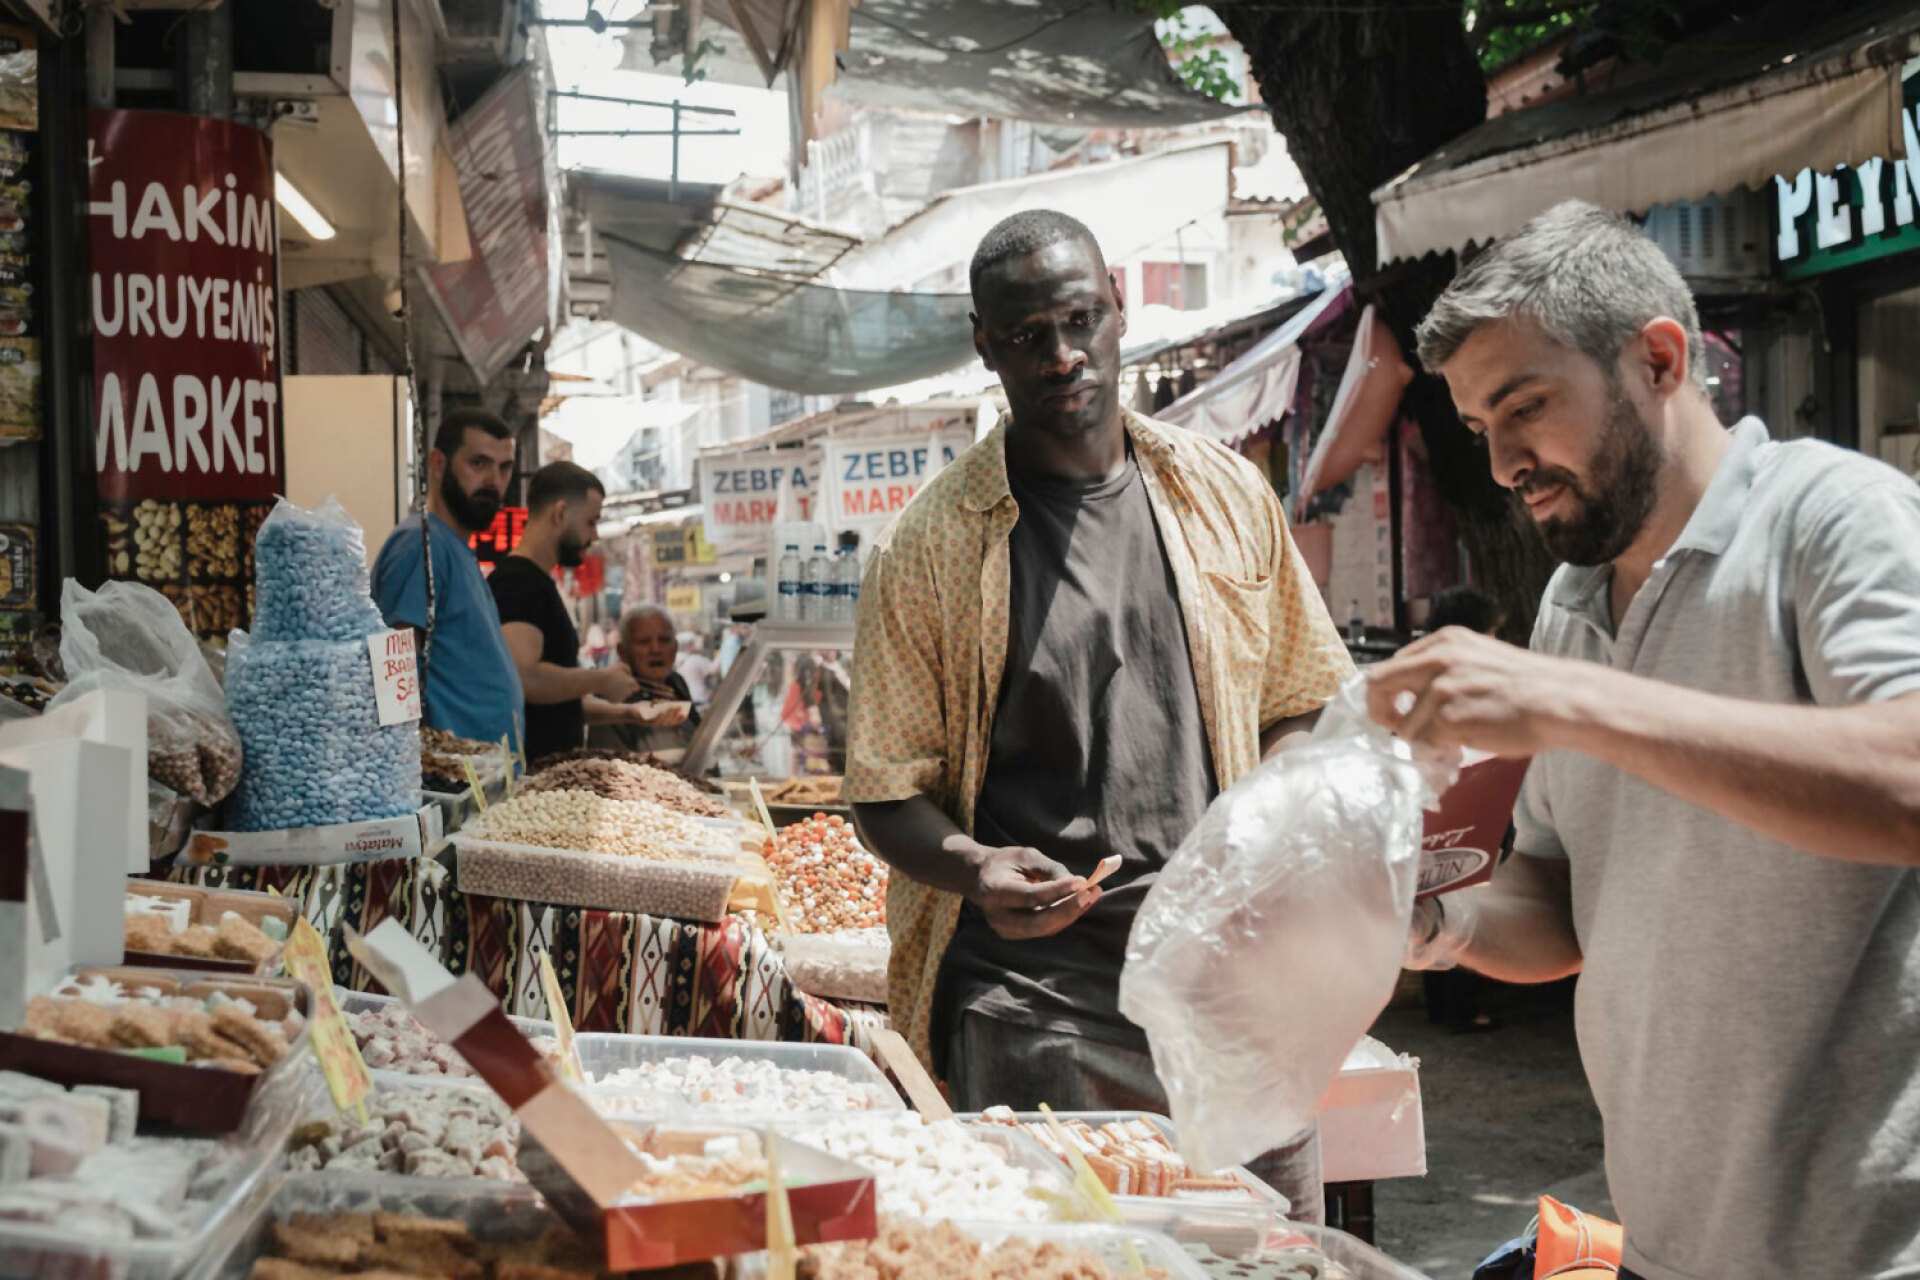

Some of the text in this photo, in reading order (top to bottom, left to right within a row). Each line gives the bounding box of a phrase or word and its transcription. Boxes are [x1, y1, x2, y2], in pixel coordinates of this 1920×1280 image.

[89, 173, 273, 256] HAKİM
[95, 371, 277, 477] MARKET
[713, 497, 809, 525] MARKT
